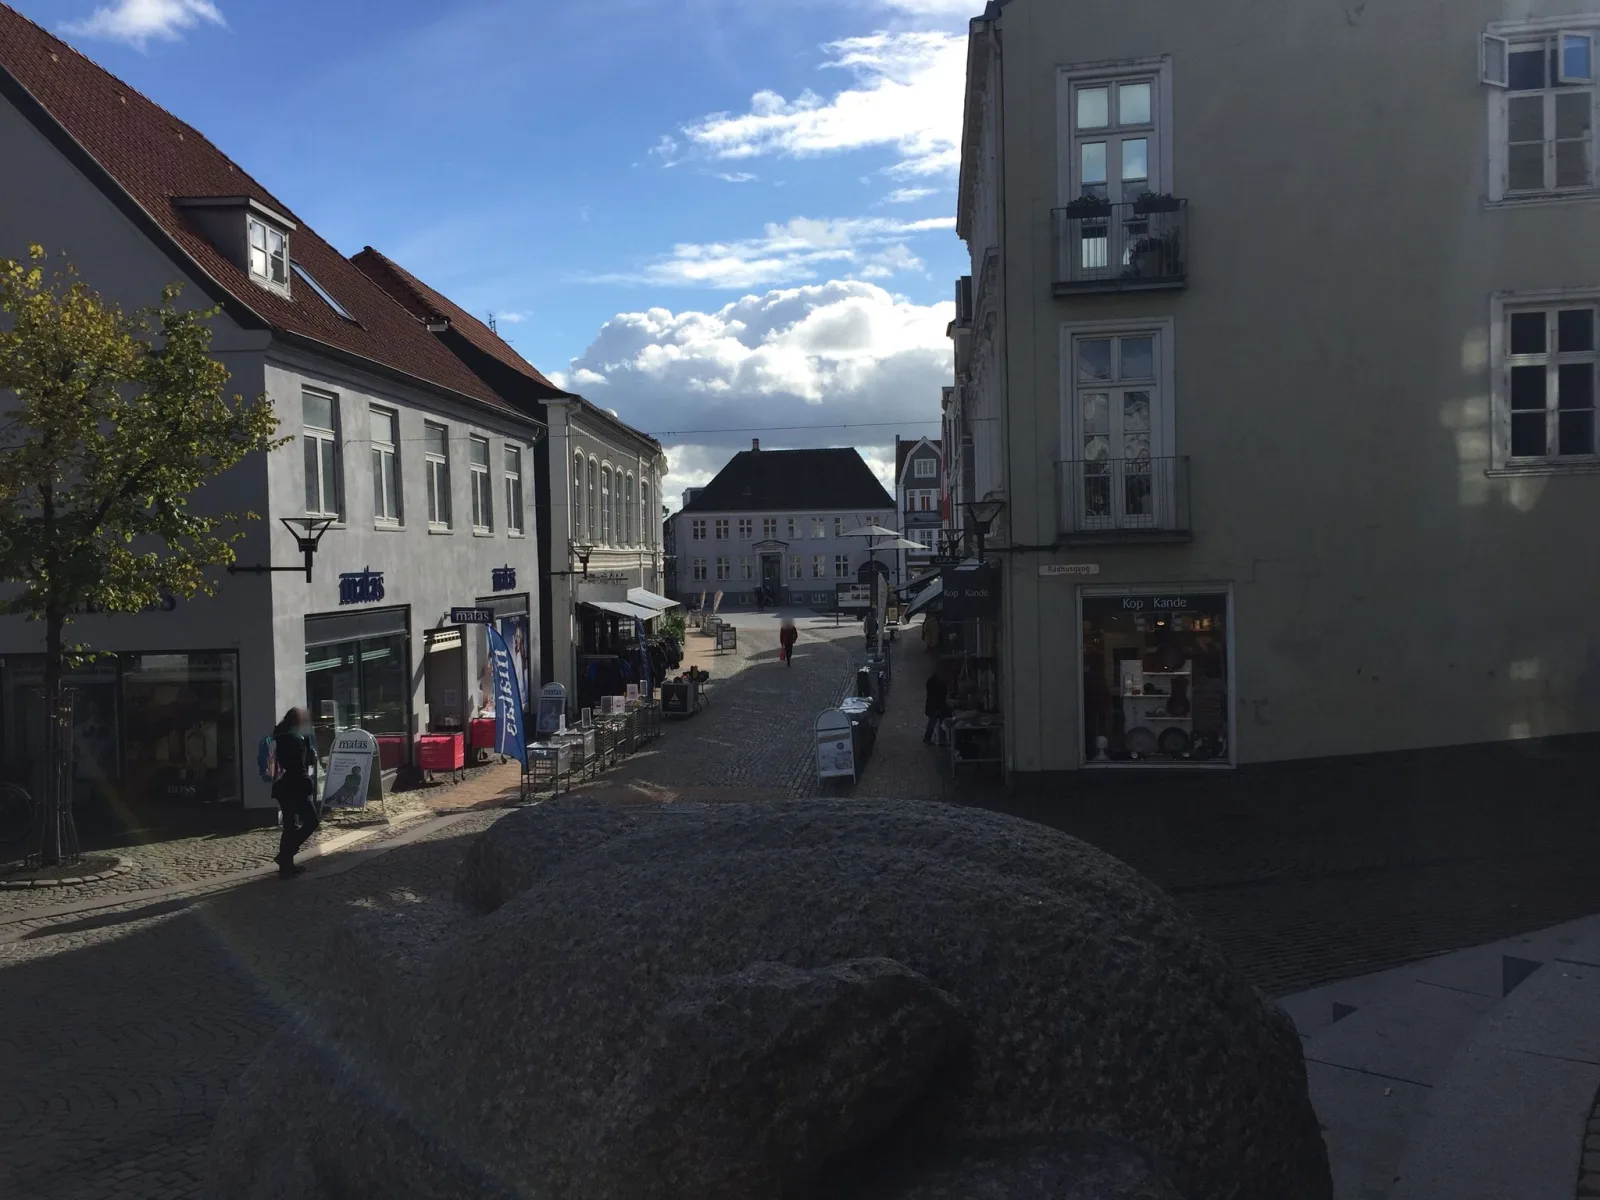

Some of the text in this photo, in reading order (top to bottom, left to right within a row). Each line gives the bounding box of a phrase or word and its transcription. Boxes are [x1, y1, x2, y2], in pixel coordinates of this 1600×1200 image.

[338, 565, 385, 606] matas
[943, 588, 989, 599] Kop Kande
[1122, 597, 1187, 611] Kop Kande
[455, 609, 490, 621] matas
[494, 649, 518, 737] matas
[338, 739, 368, 749] matas
